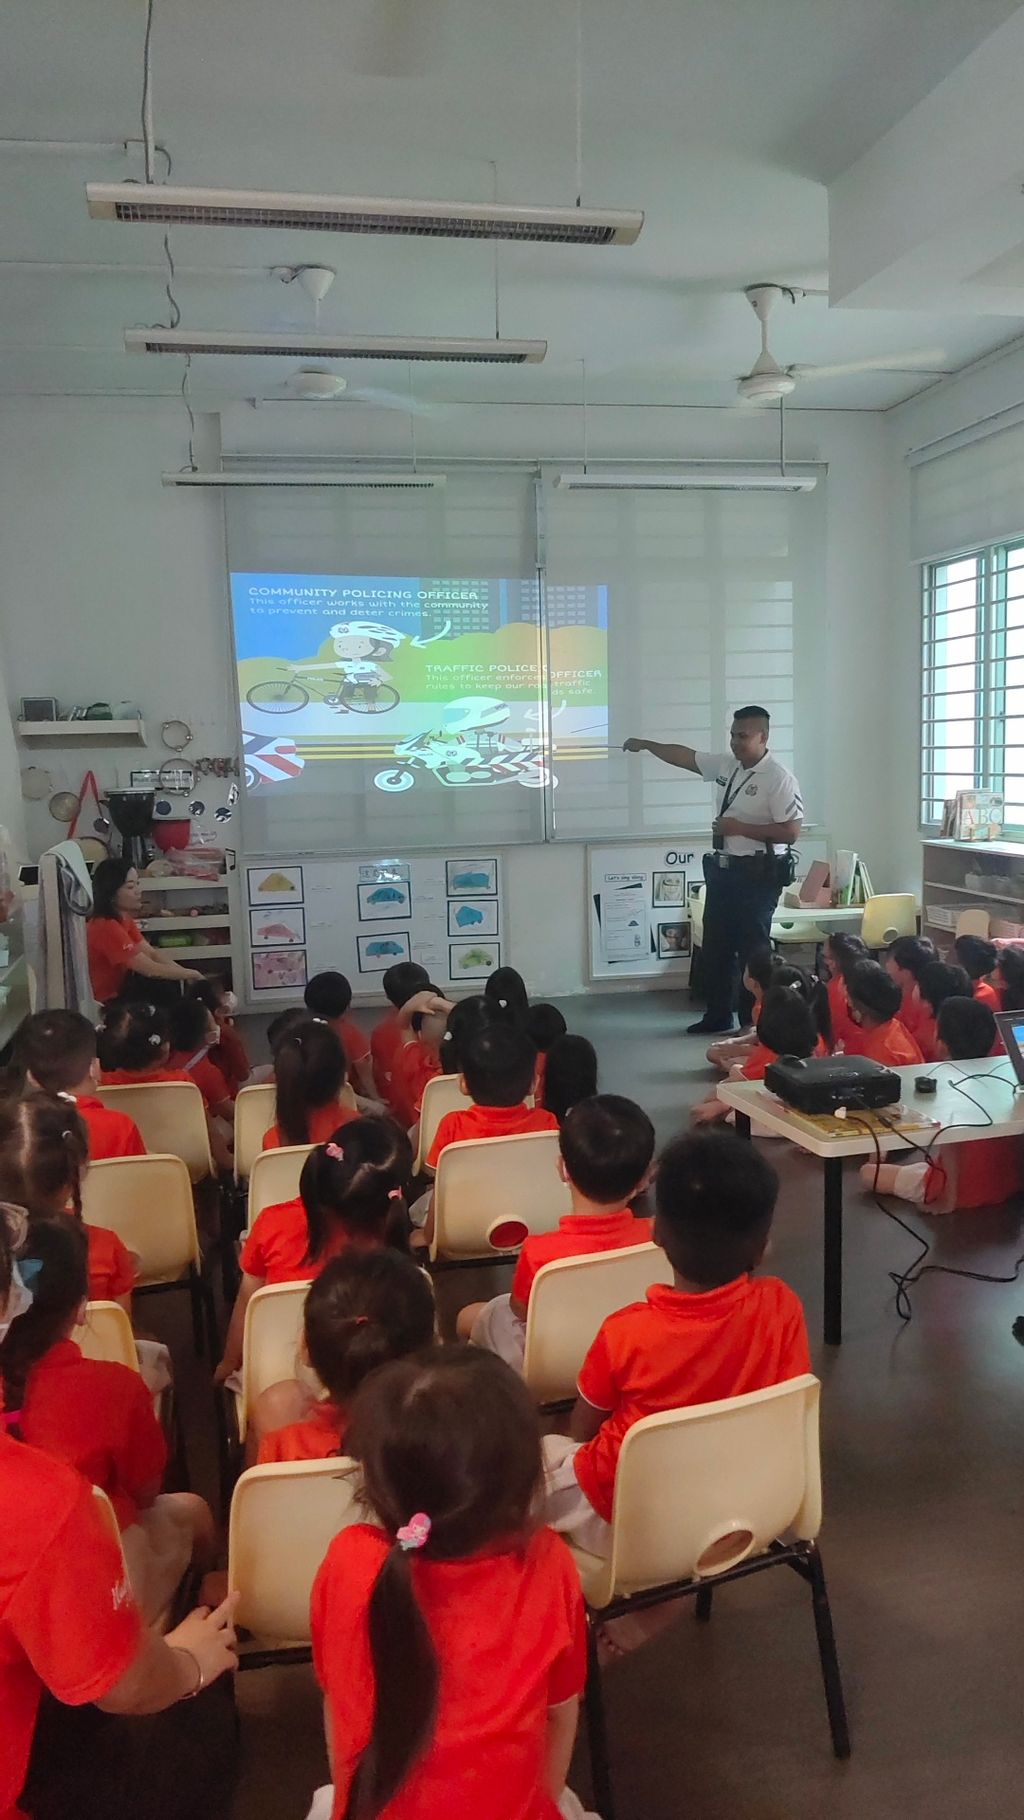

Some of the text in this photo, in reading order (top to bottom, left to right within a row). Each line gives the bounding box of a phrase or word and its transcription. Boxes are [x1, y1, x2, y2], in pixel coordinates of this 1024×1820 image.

[248, 587, 478, 600] COMMUNITY POLICING OFFICER
[279, 598, 322, 606] officer
[327, 599, 365, 607] works
[423, 601, 489, 609] community
[425, 664, 602, 678] TRAFFIC POLICE OFFICER
[453, 673, 493, 681] officer
[554, 680, 591, 688] traffic
[476, 683, 502, 692] keep
[665, 851, 694, 865] Our
